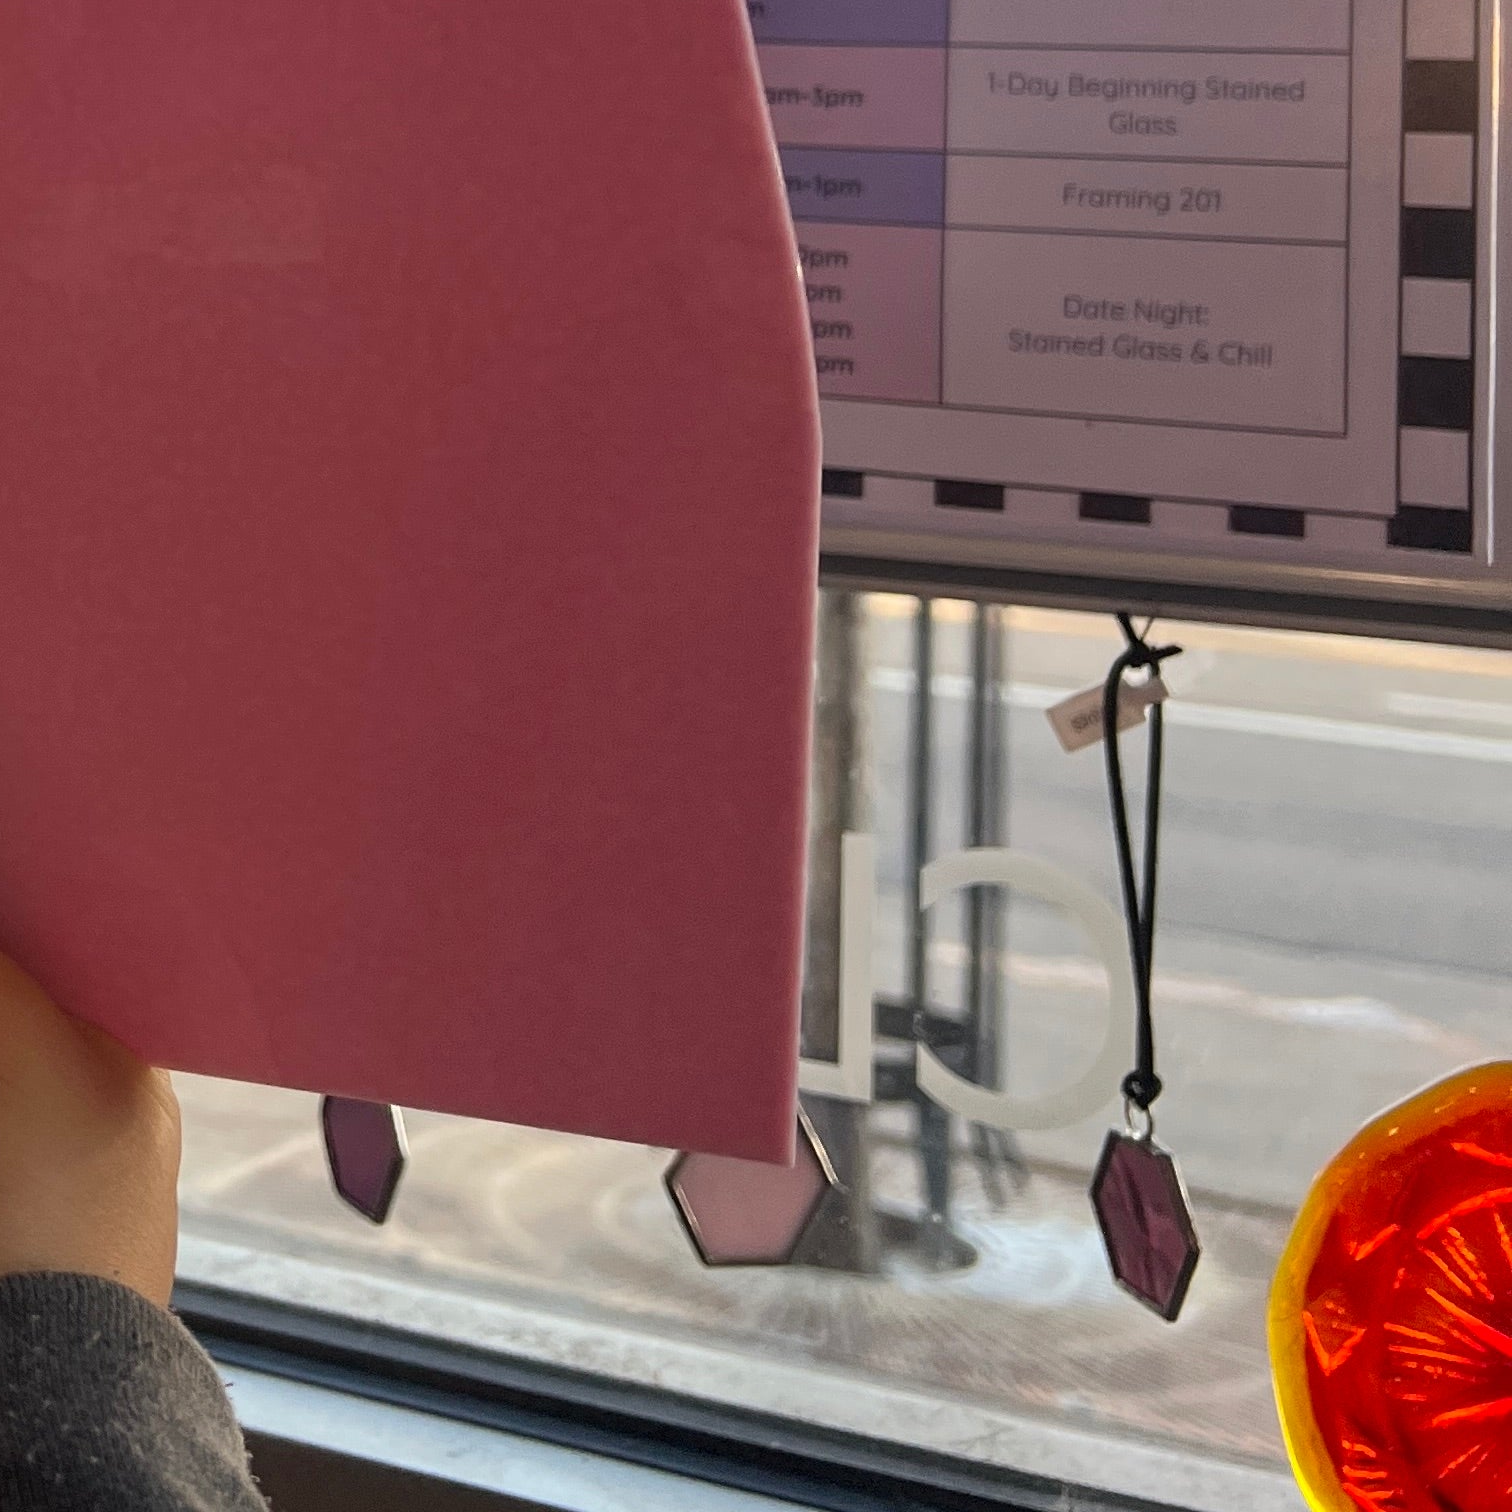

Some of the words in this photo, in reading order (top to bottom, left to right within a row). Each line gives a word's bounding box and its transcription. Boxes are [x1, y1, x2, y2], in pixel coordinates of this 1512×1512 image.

[766, 84, 865, 109] am-3pm
[987, 71, 1059, 101] 1-Day
[1068, 73, 1197, 105] Beginning
[1205, 75, 1306, 102] Stained
[1108, 110, 1178, 136] Glass
[1062, 181, 1171, 216] Framing
[1180, 186, 1223, 214] 201
[1062, 294, 1125, 321] Date
[1008, 327, 1104, 358] Stained
[1112, 332, 1183, 362] Glass
[1190, 339, 1211, 365] &
[1218, 341, 1274, 368] Chill
